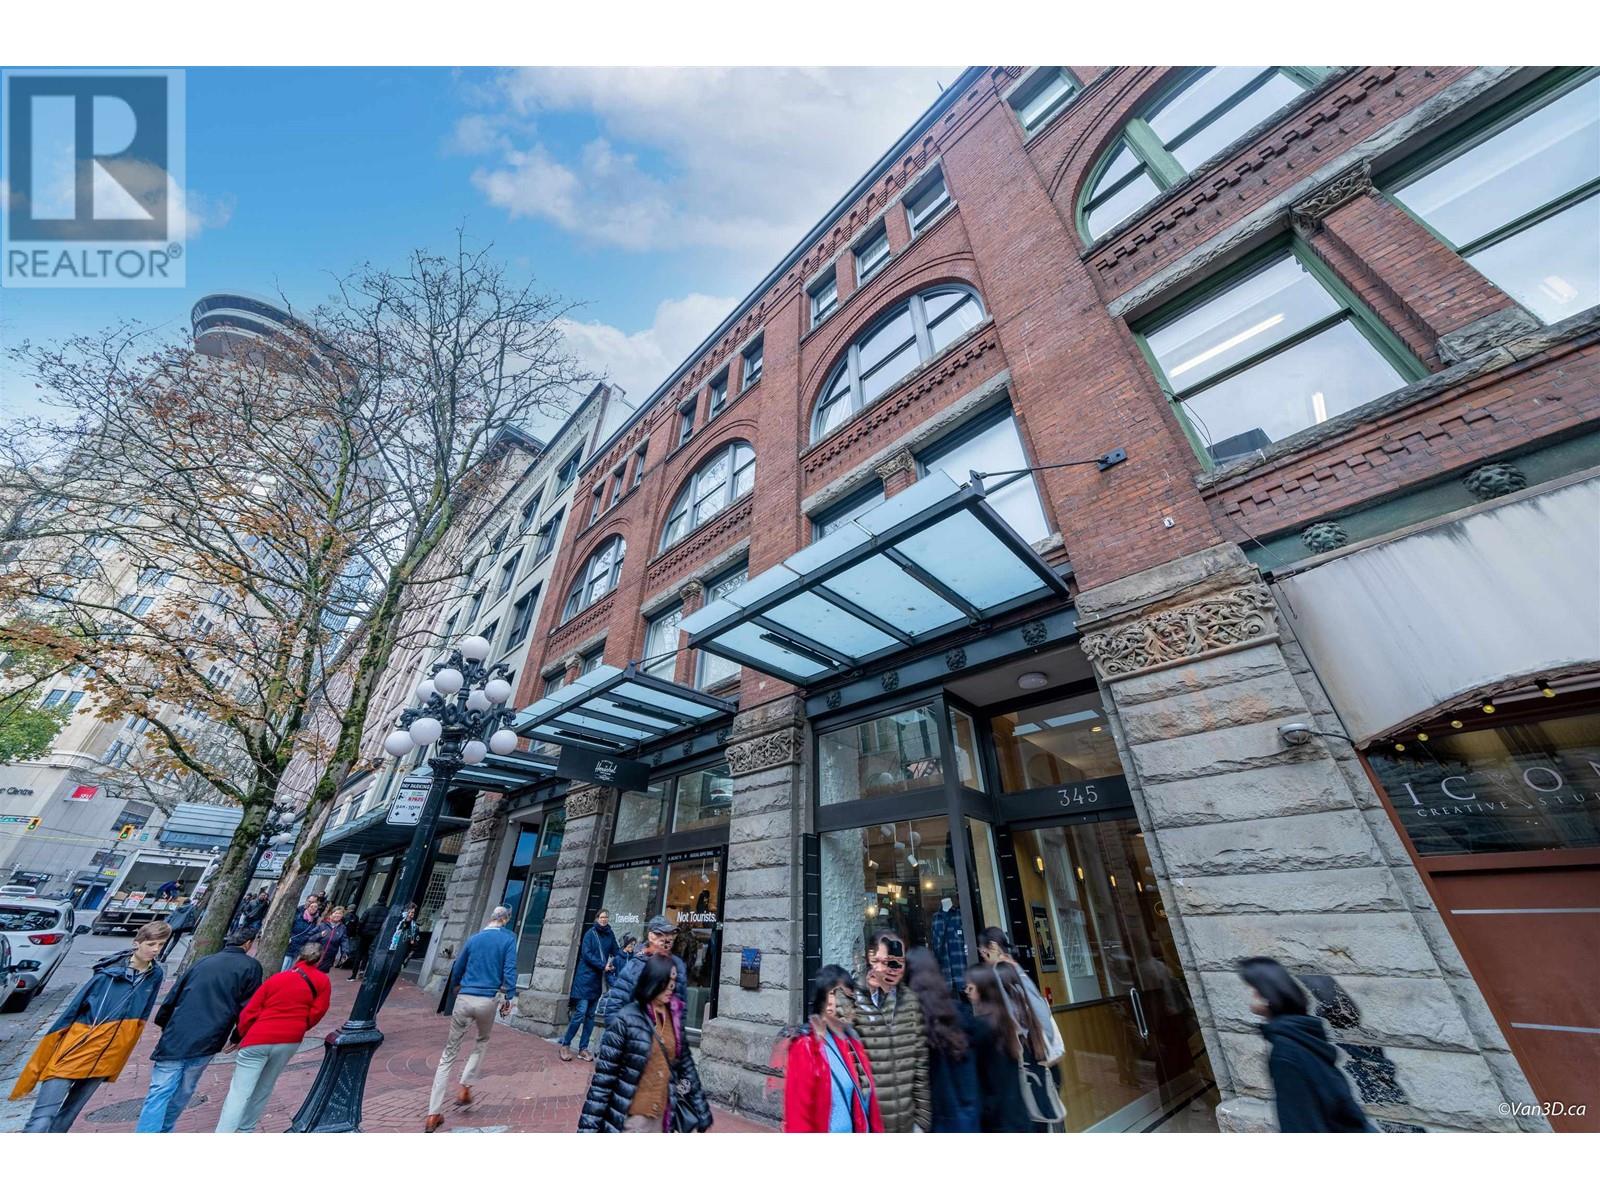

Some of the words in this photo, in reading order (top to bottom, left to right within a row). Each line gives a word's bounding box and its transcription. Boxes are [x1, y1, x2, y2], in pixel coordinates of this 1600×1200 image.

[7, 786, 34, 796] Centre
[1057, 785, 1098, 807] 345
[1417, 801, 1509, 817] CREATIVE
[677, 911, 689, 922] Not
